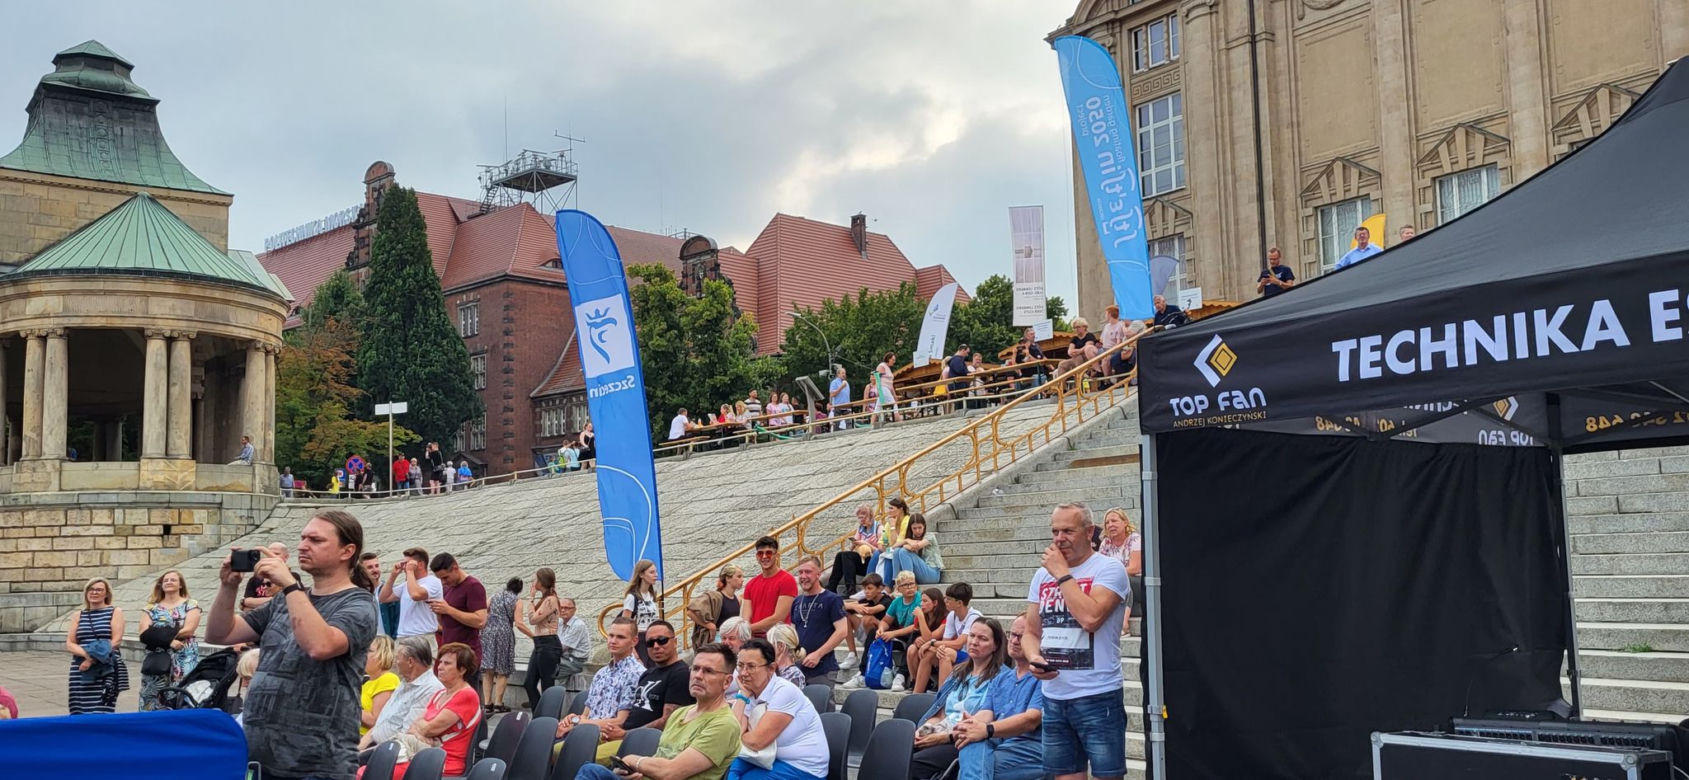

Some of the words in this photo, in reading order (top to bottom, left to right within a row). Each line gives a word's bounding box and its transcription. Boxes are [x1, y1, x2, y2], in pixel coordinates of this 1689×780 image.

[1649, 289, 1689, 343] E
[1332, 299, 1631, 382] TECHNIKA
[1169, 394, 1209, 417] TOP
[1173, 417, 1206, 428] ANDRZEJ
[1207, 411, 1267, 425] KONIECZYŃSKI
